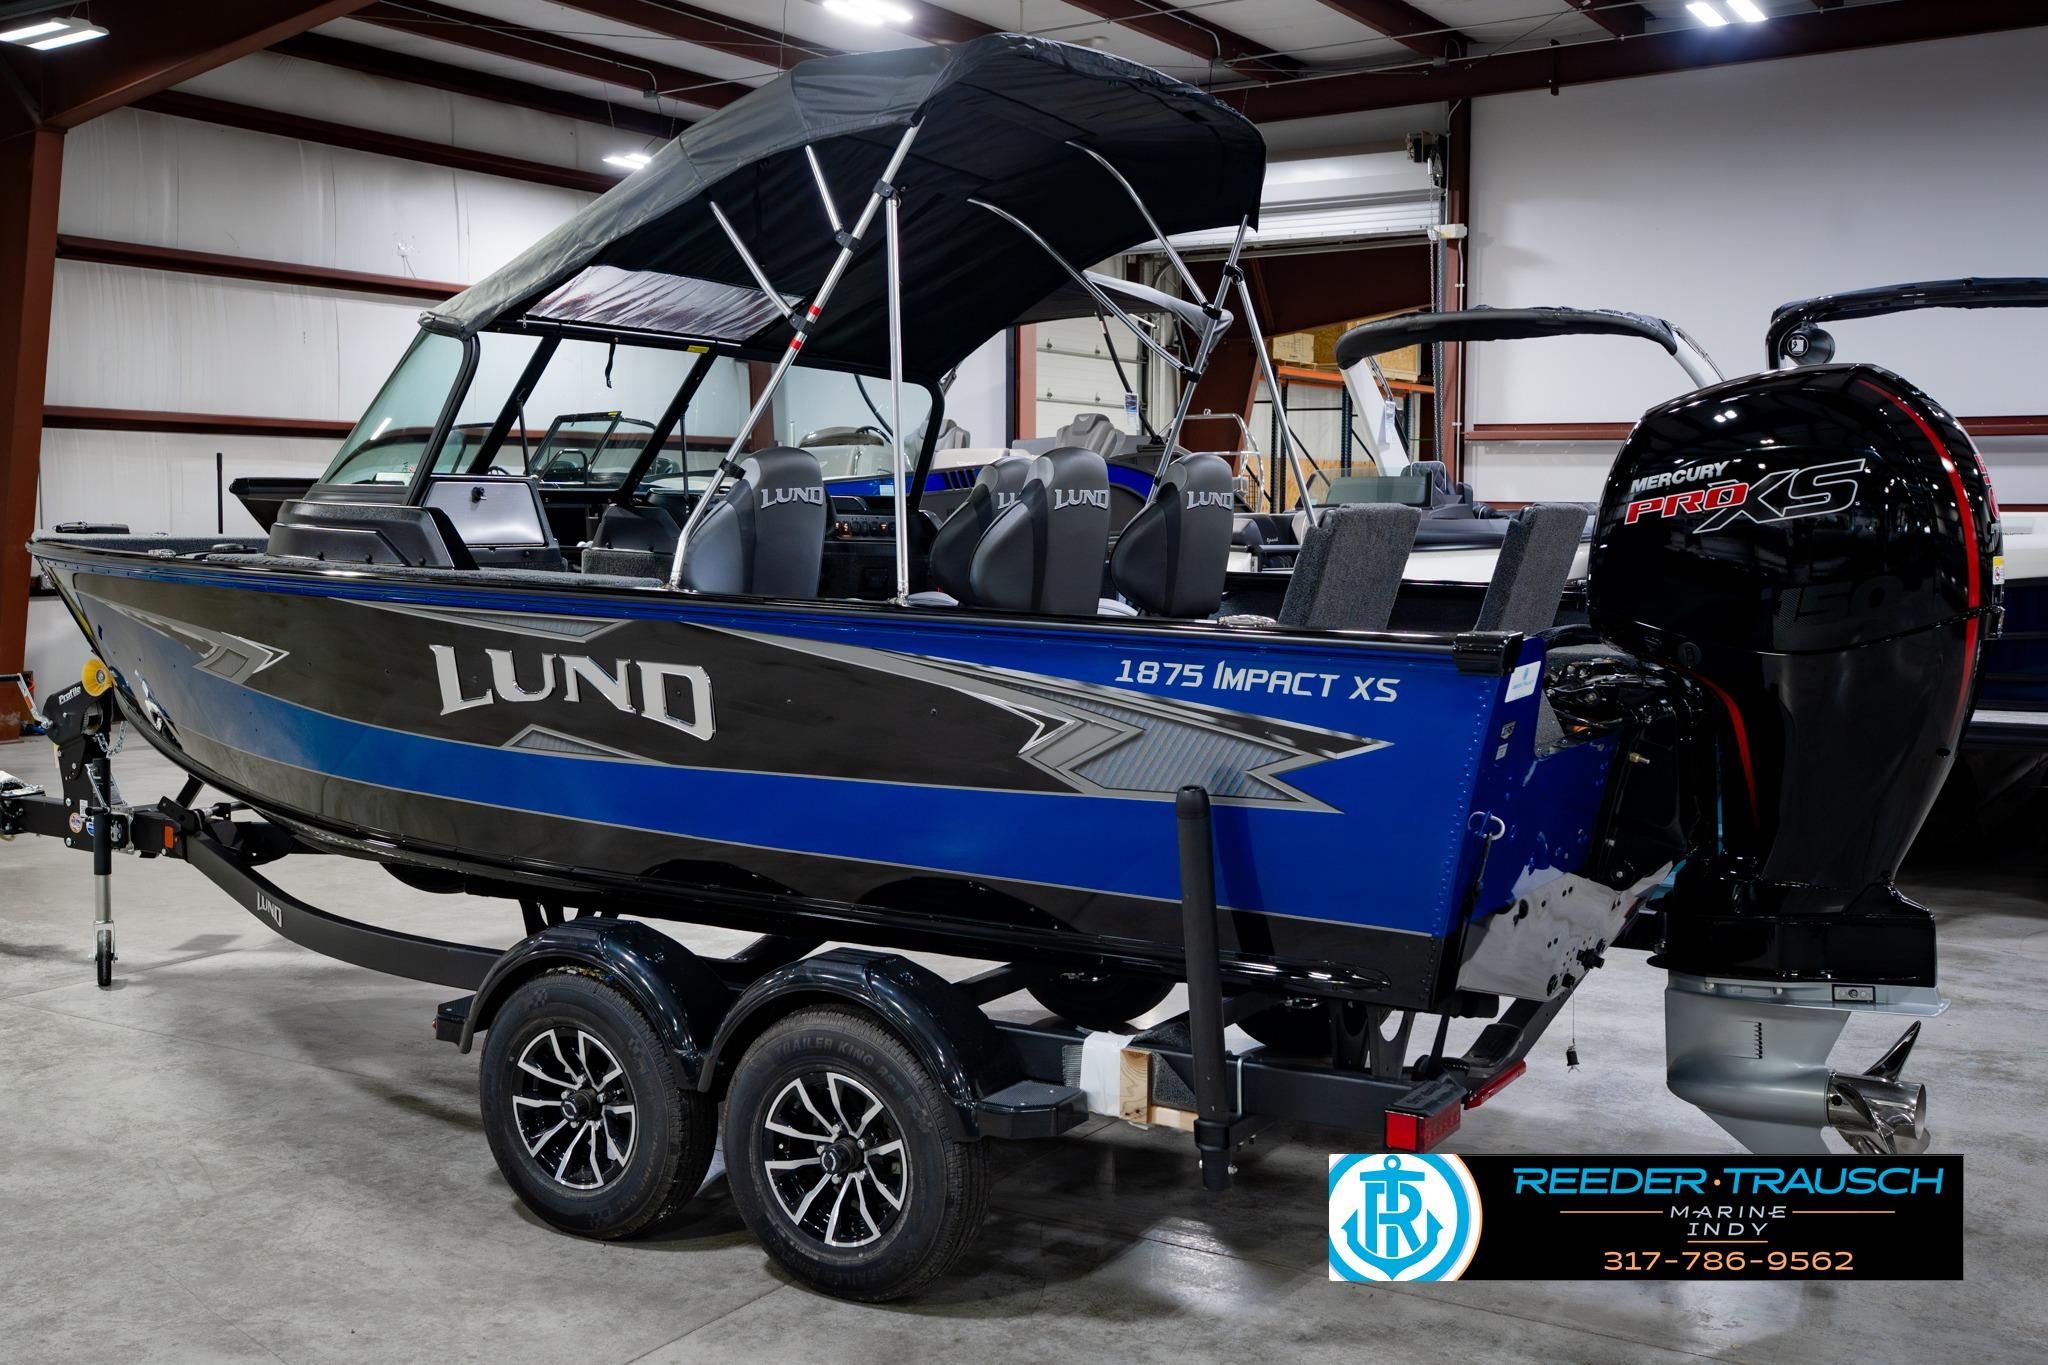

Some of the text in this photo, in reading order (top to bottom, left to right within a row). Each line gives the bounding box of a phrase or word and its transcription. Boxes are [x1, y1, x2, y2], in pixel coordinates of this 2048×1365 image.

[1630, 460, 1730, 493] MERCURY
[761, 486, 824, 509] LUND
[1054, 489, 1109, 510] LUND
[1186, 491, 1233, 511] LUND
[1624, 458, 1866, 534] PRO XS
[429, 644, 717, 741] LUND
[1115, 659, 1205, 688] 1875
[1348, 675, 1401, 702] XS
[58, 686, 81, 705] Profile
[257, 891, 282, 928] LUND
[838, 1041, 875, 1066] KING
